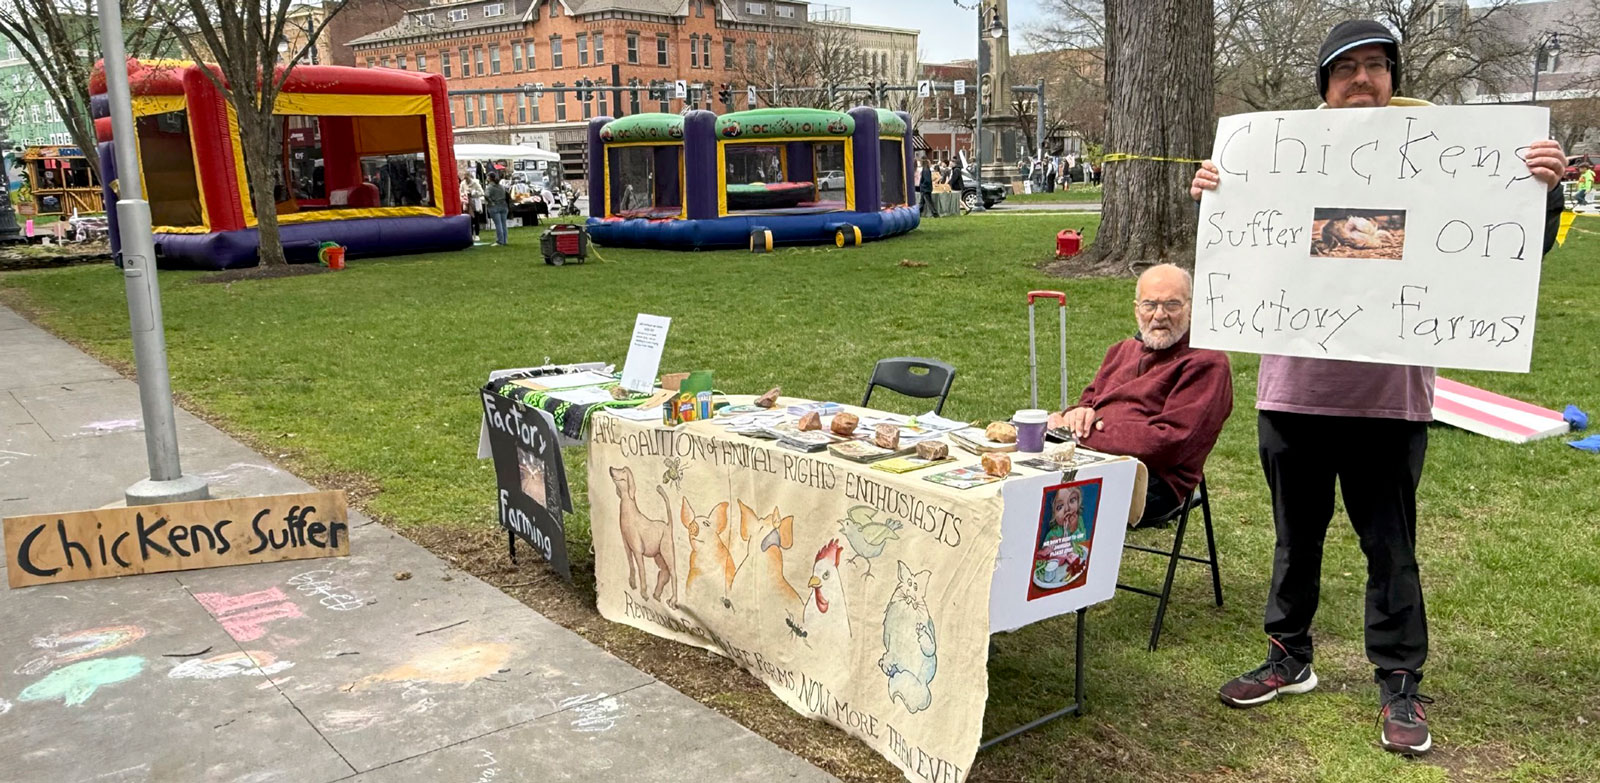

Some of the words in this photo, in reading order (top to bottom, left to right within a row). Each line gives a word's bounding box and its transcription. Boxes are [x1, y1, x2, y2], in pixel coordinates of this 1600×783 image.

[1206, 208, 1303, 249] Suffer
[1435, 218, 1527, 261] on
[482, 392, 547, 455] Factory
[619, 428, 707, 461] COALITION
[706, 435, 719, 466] of
[721, 440, 776, 474] ANIMAL
[783, 453, 836, 490] RIGHTS
[845, 471, 963, 548] ENTHUSIASTS
[248, 504, 349, 556] Suffer
[499, 488, 553, 562] Farming
[834, 697, 880, 740] MORE
